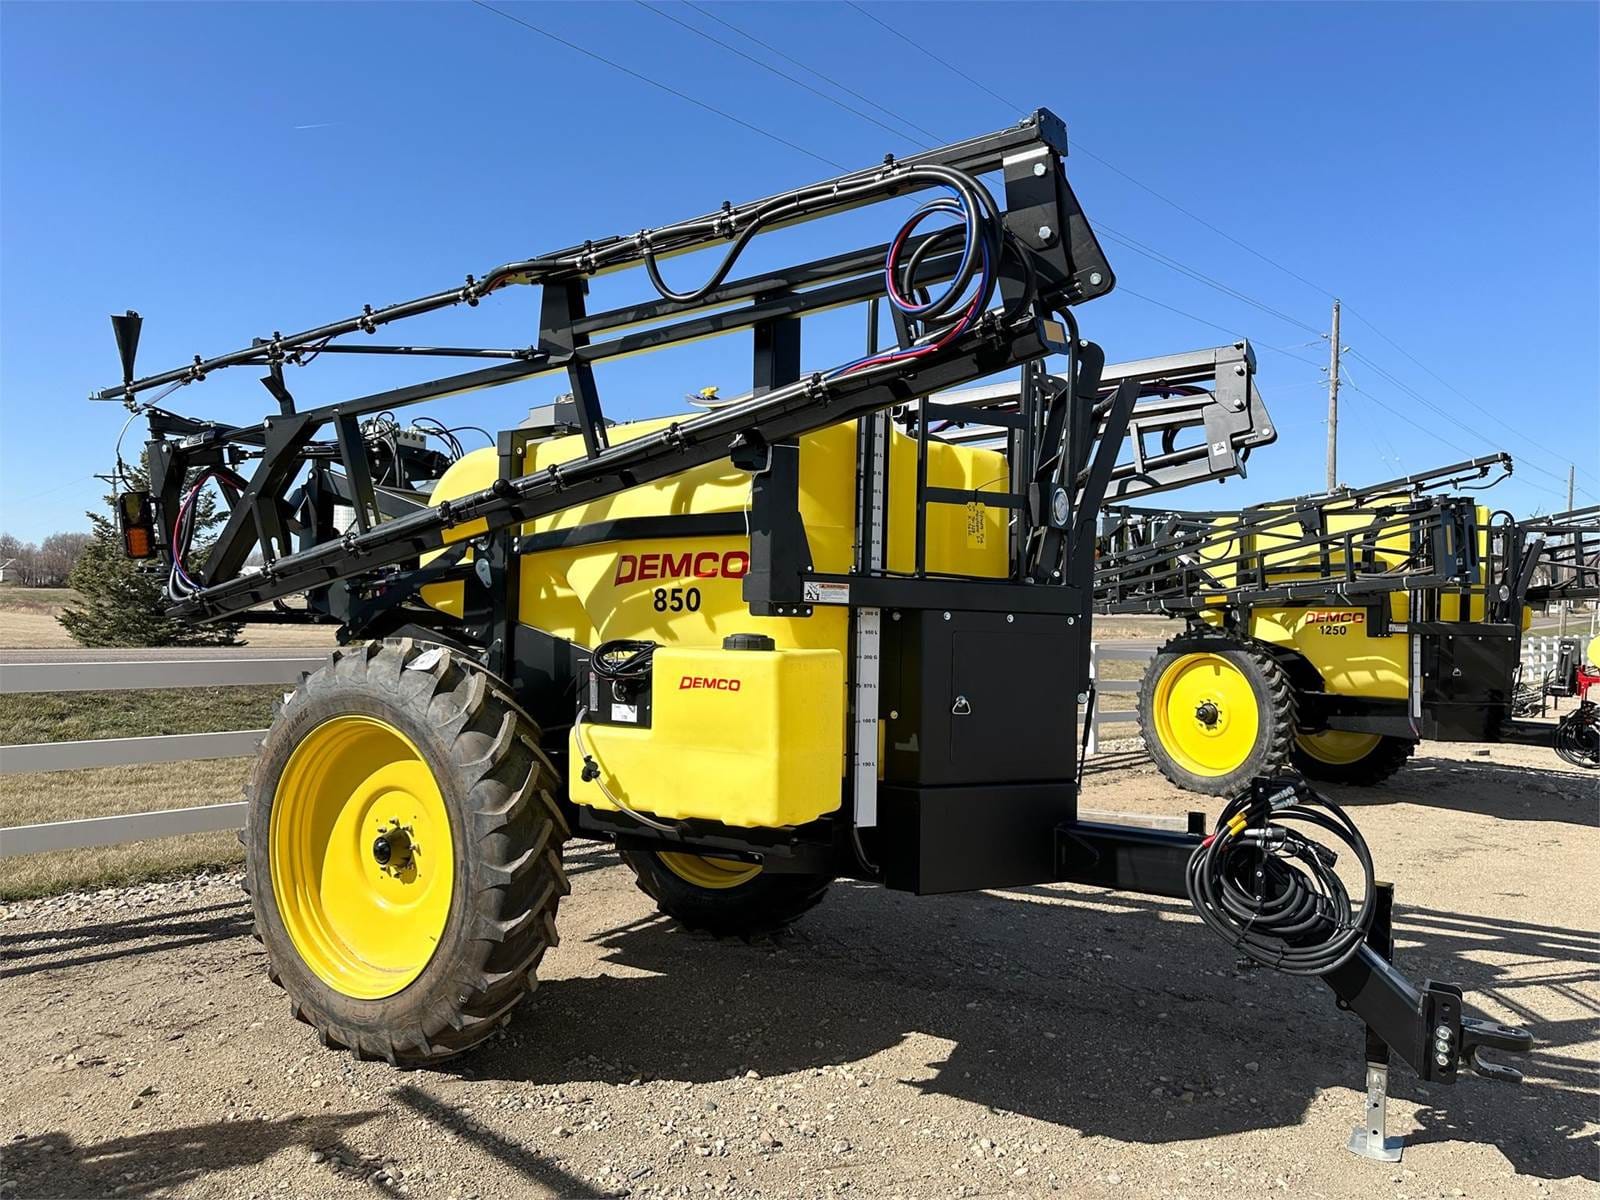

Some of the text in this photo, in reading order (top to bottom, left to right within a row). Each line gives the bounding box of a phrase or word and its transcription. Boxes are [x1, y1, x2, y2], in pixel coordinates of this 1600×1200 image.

[614, 551, 749, 587] DEMCO
[653, 587, 701, 612] 850
[1306, 612, 1365, 624] DEMCO
[1320, 625, 1347, 635] 1250
[678, 676, 741, 691] DEMCO
